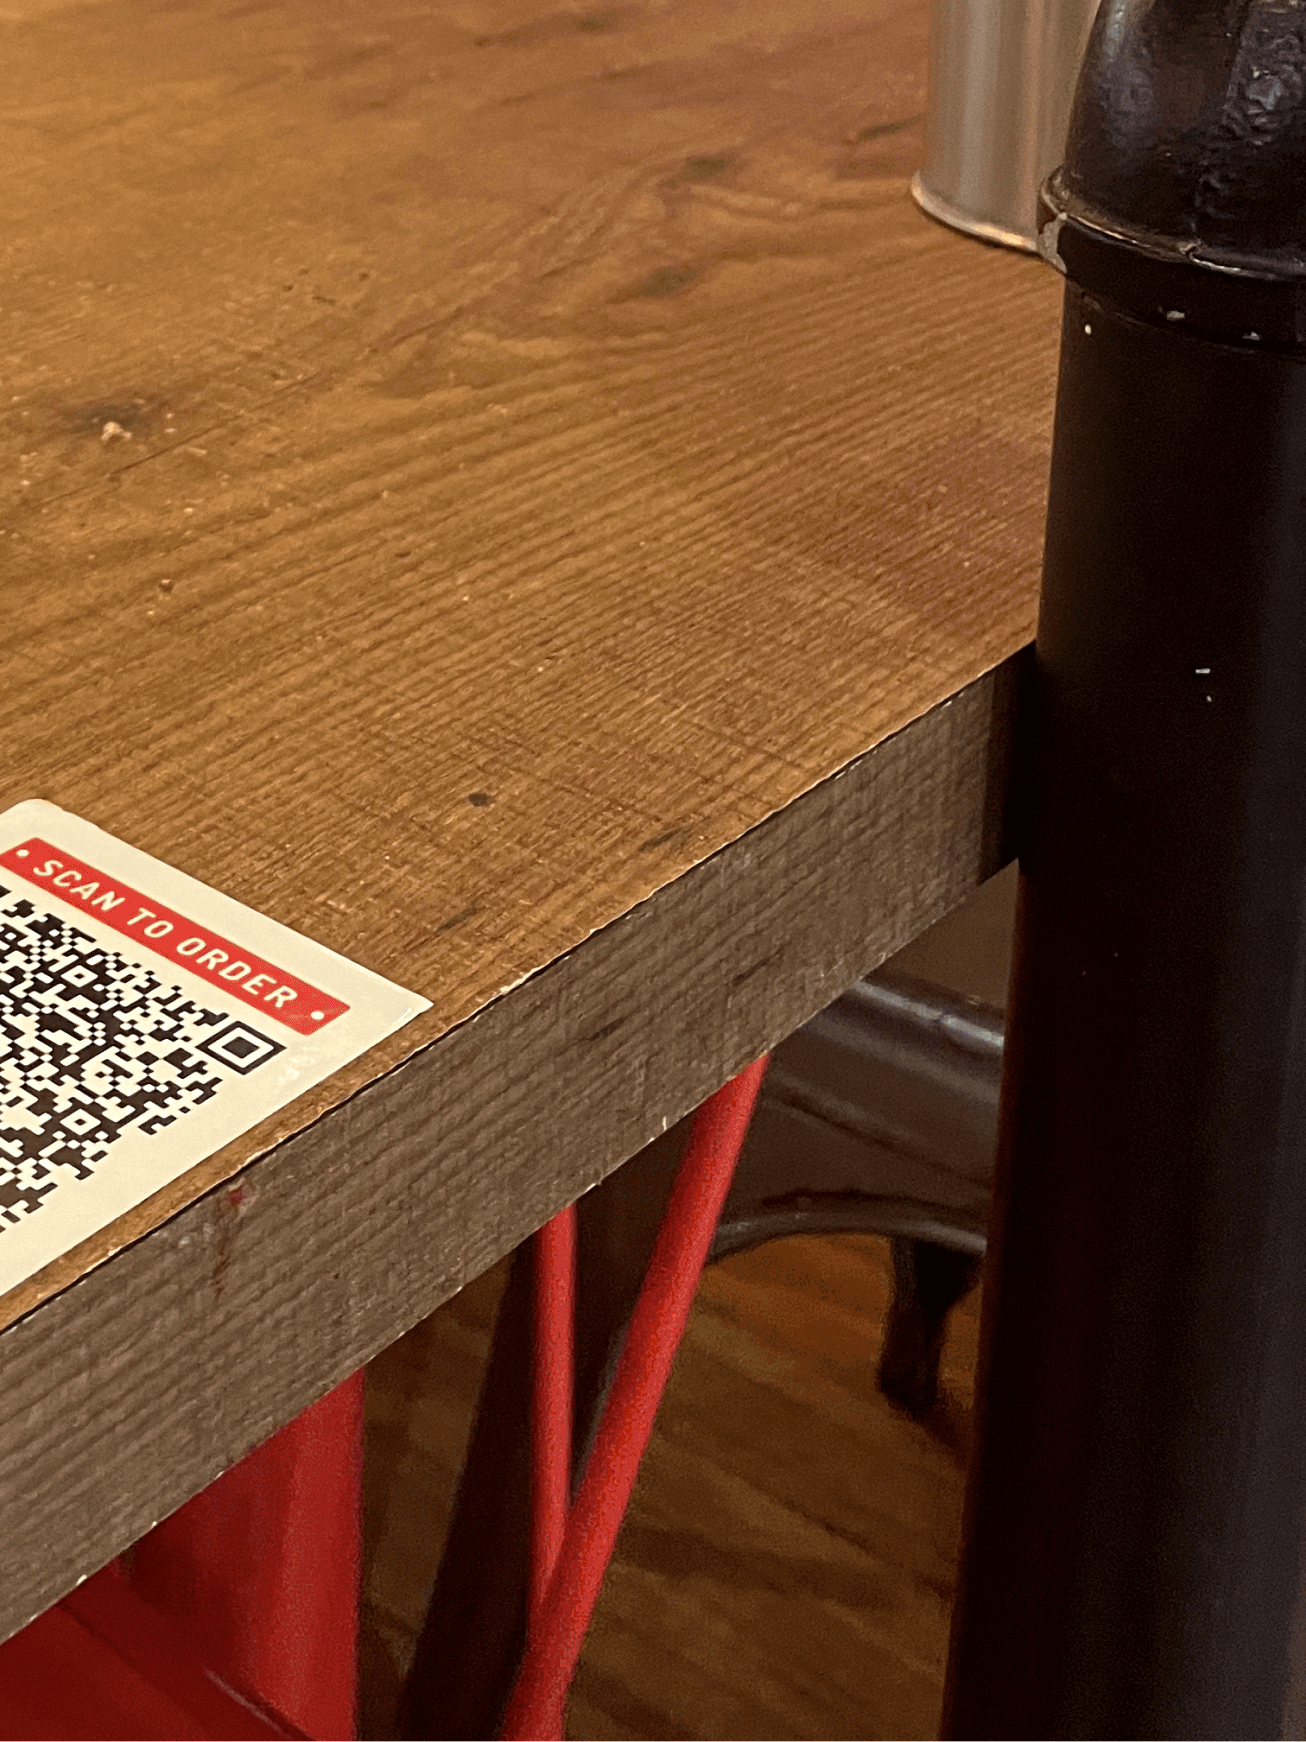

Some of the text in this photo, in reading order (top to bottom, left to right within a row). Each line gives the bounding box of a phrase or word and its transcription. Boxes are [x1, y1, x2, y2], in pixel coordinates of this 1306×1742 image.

[33, 859, 298, 1008] SCAN TO ORDER
